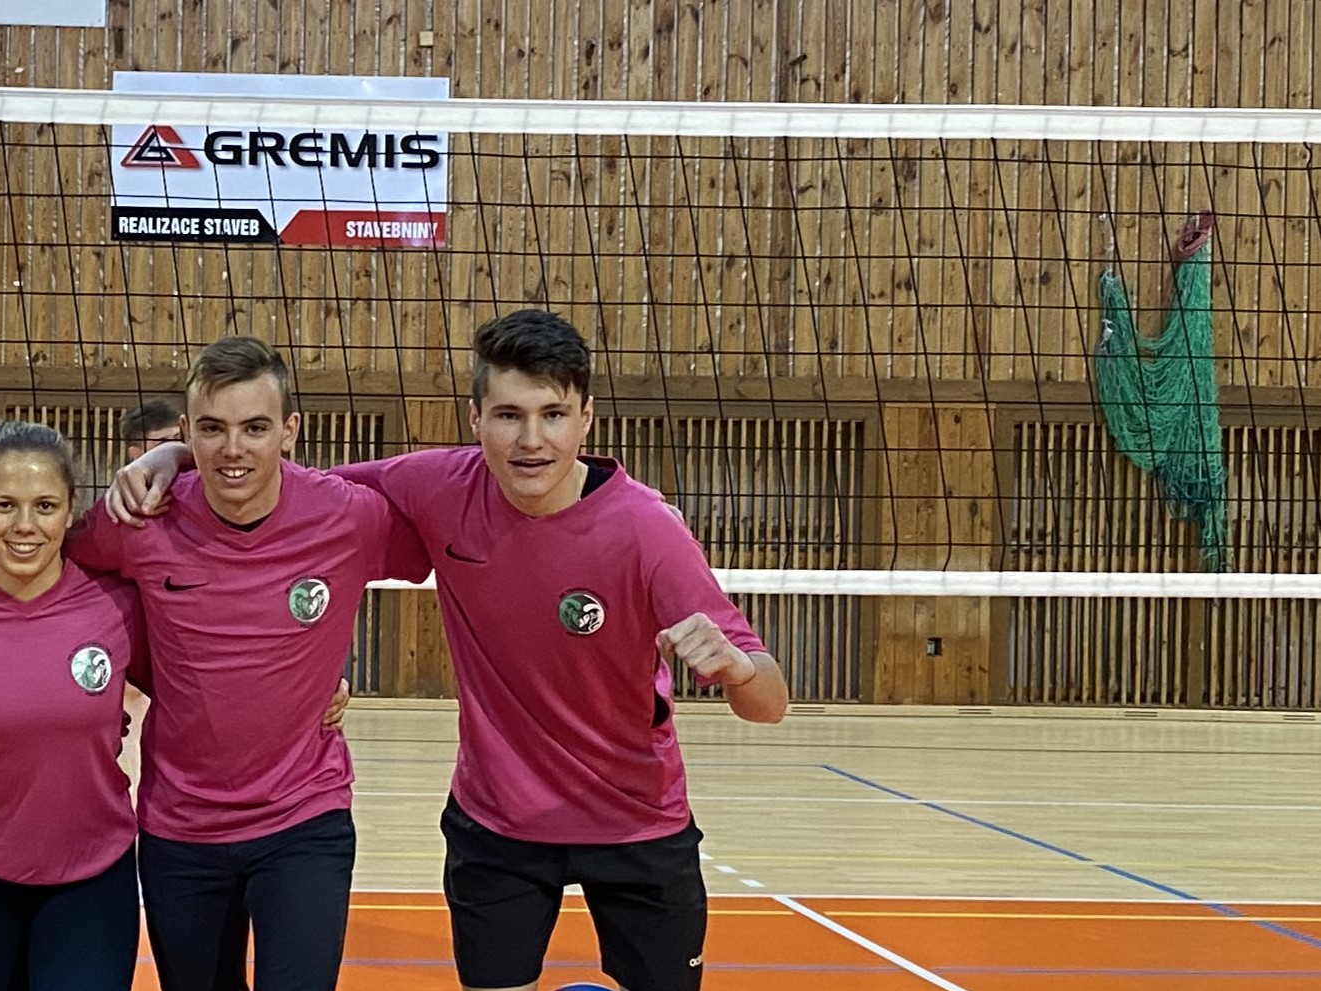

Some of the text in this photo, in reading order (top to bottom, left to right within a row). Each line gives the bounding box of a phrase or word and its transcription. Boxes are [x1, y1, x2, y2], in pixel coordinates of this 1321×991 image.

[204, 130, 439, 169] GREMIS
[119, 217, 260, 236] REALIZACE STAVEB
[345, 220, 438, 239] STAVEBNINY
